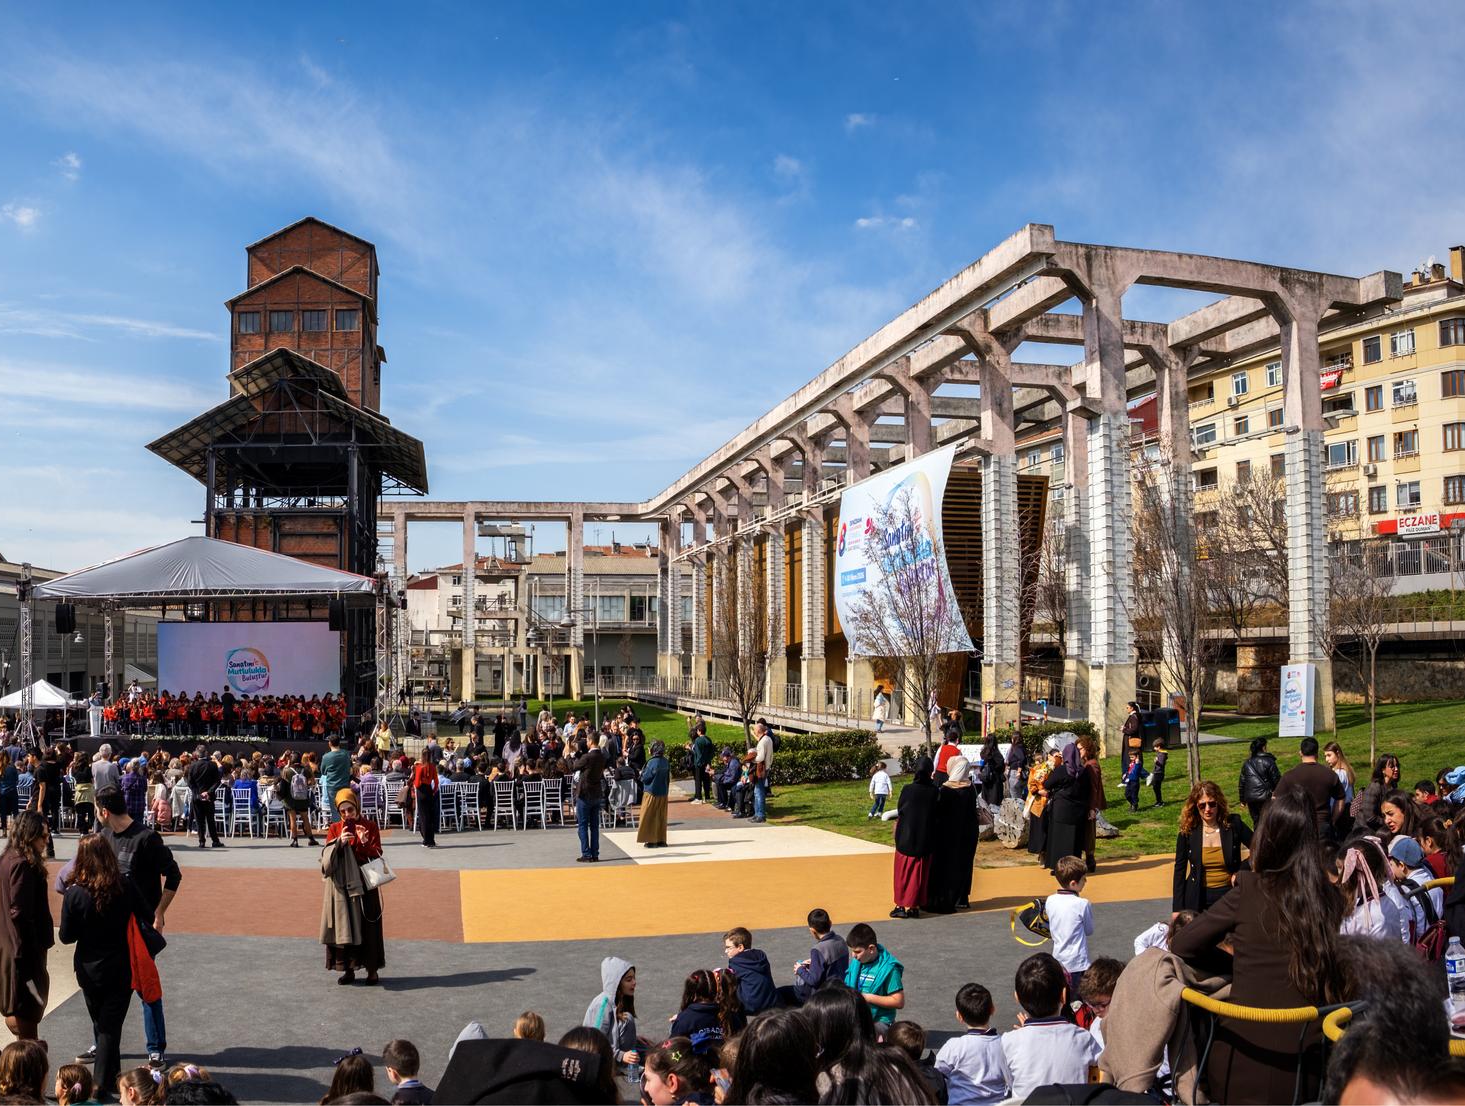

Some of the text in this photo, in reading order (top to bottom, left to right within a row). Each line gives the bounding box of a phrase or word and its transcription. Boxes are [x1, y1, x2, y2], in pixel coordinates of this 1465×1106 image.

[1399, 514, 1437, 528] ECZANE
[227, 666, 267, 675] Mutlulukla
[241, 672, 267, 682] Buluştur
